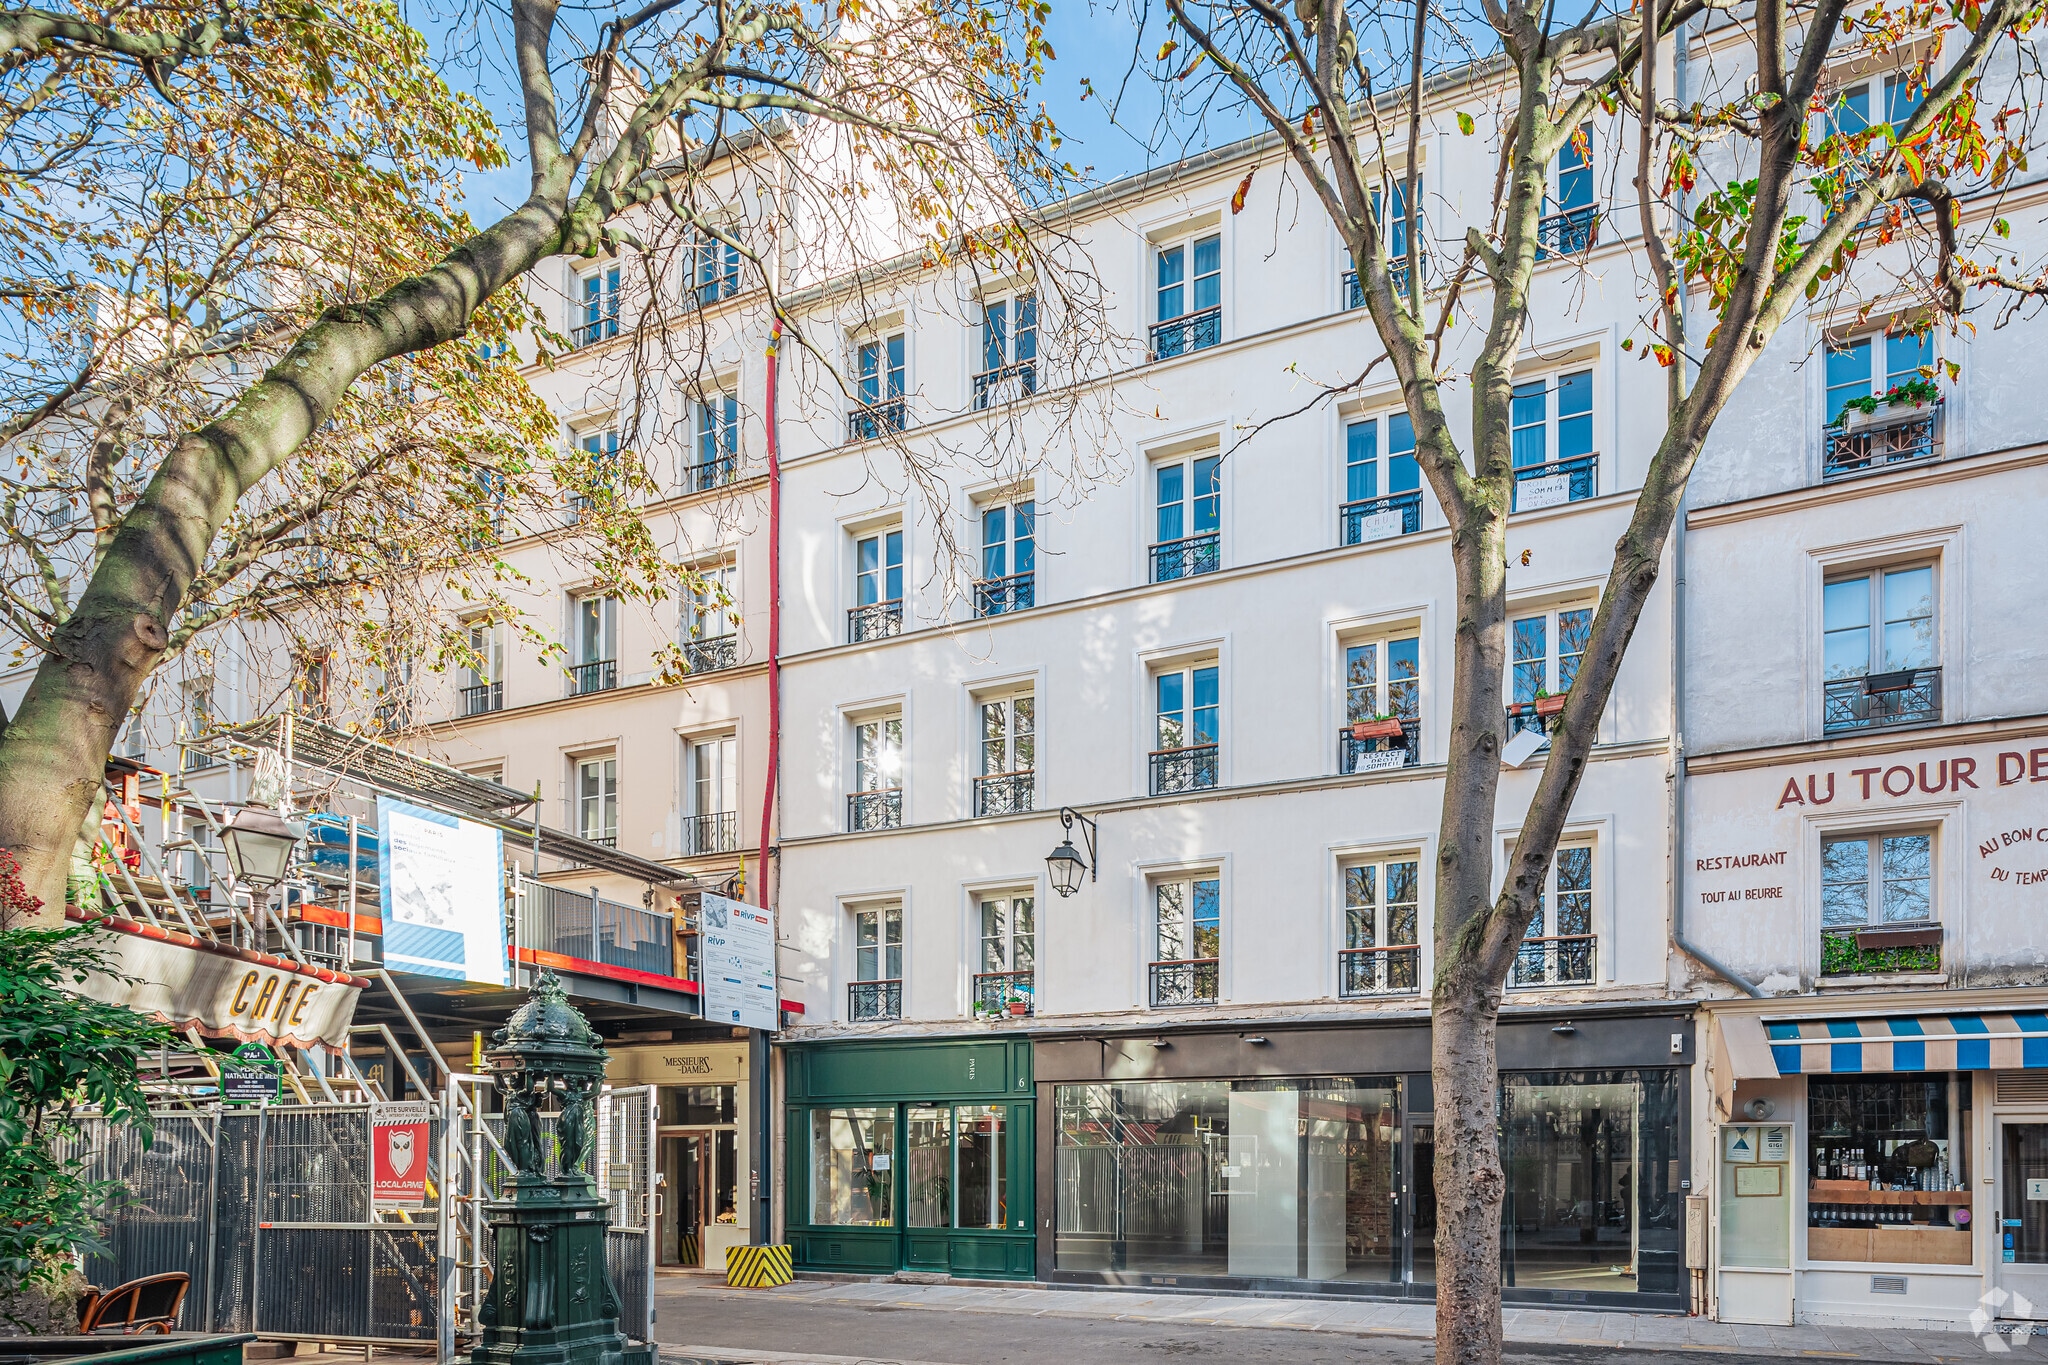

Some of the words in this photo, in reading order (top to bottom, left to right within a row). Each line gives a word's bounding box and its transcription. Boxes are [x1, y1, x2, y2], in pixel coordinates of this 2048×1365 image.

[1365, 512, 1398, 528] CHUT
[1363, 750, 1402, 760] RESPECT
[1775, 772, 1835, 811] AU
[1850, 757, 1980, 800] TOUR
[1979, 837, 2000, 859] AU
[2001, 827, 2033, 847] BON
[1696, 851, 1788, 872] RESTAURANT
[1990, 867, 2010, 882] DU
[1701, 891, 1726, 904] TOUT
[1727, 890, 1741, 901] AU
[1744, 886, 1783, 900] BEURRE
[230, 970, 320, 1026] CAFE
[968, 1058, 976, 1081] PARIS
[1018, 1077, 1025, 1088] 6
[376, 1180, 424, 1189] LOCALARME
